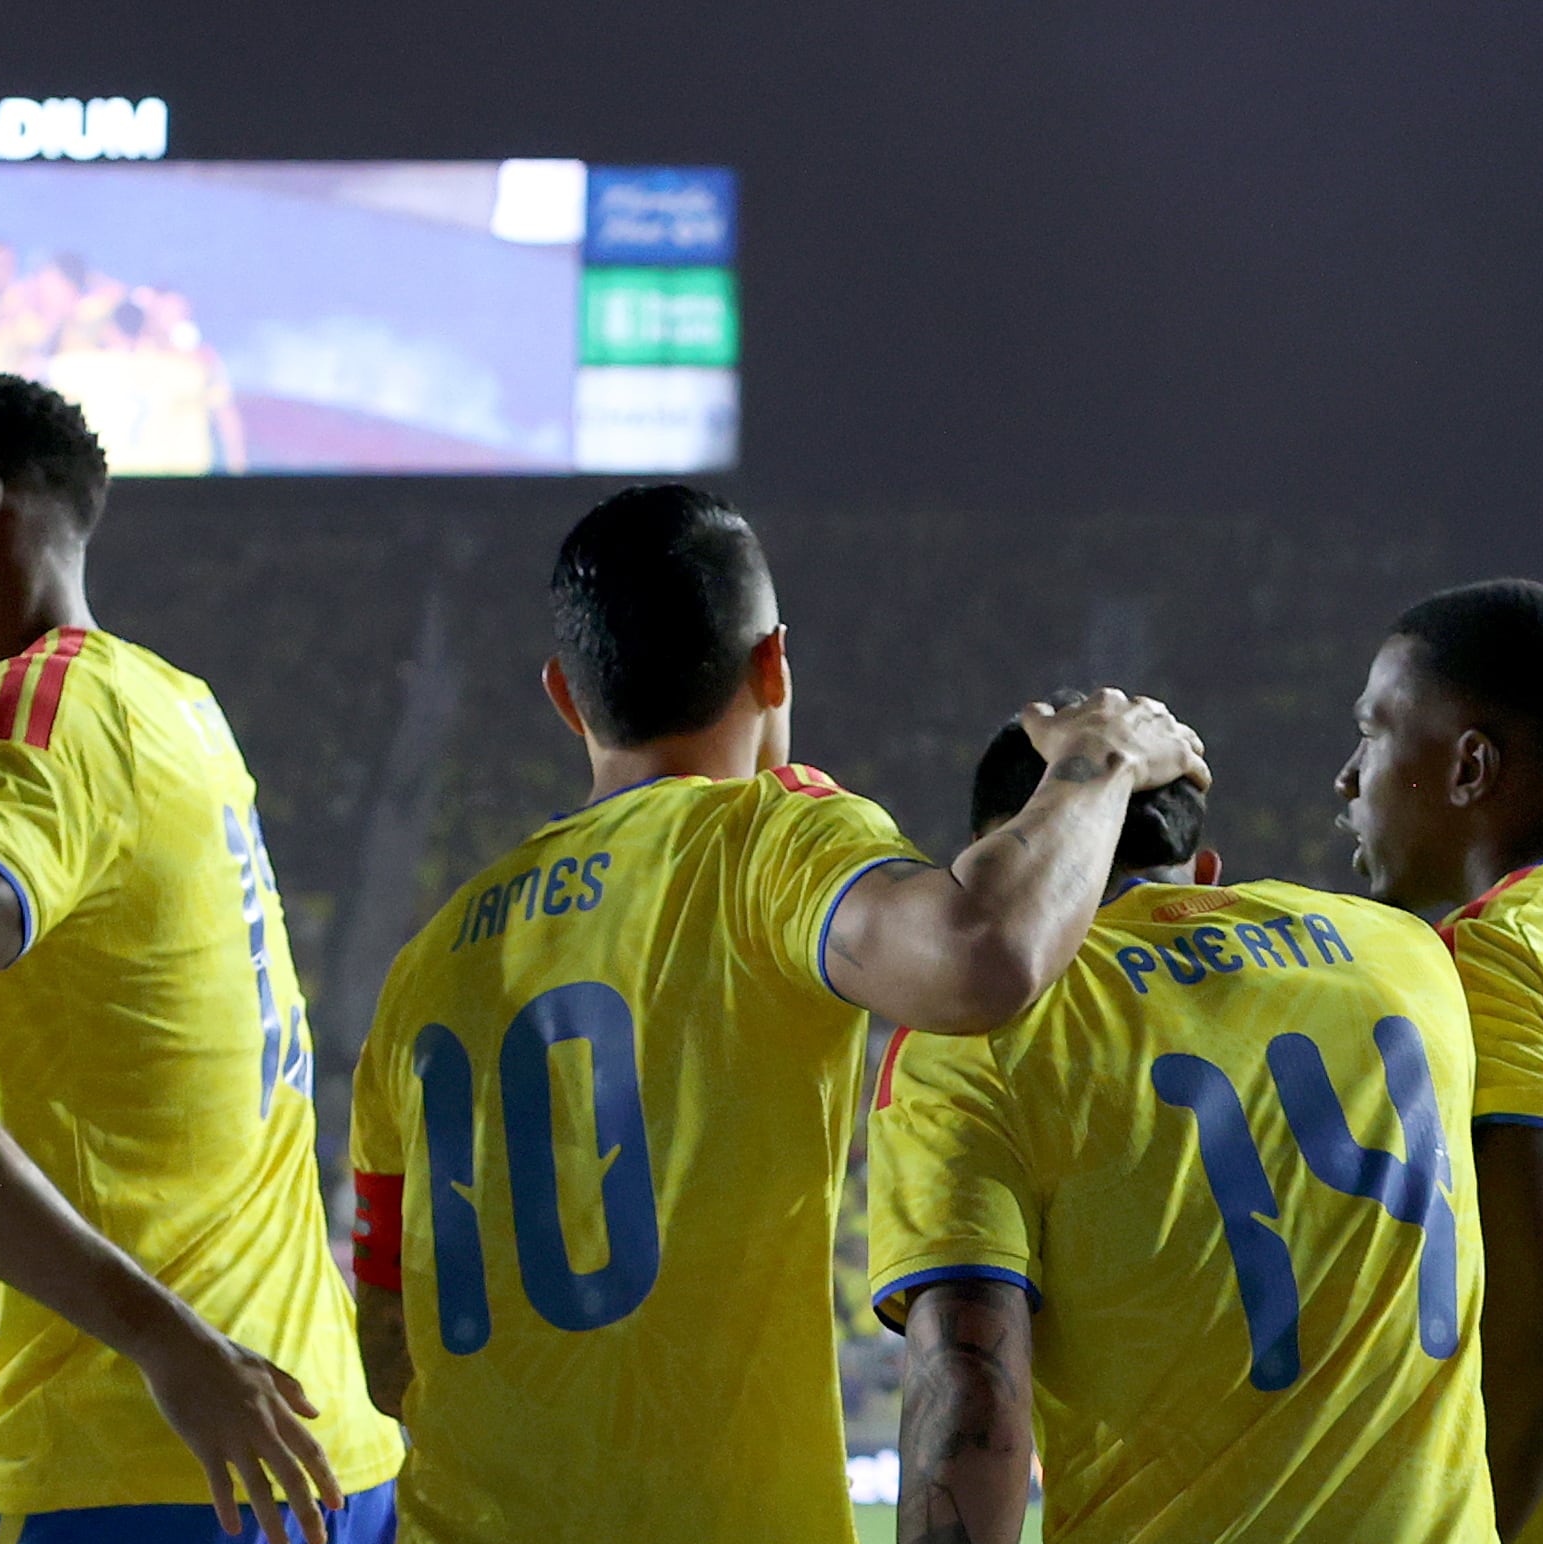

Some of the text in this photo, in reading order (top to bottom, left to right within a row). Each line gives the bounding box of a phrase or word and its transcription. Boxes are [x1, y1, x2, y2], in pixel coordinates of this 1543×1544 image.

[451, 851, 612, 953] JAMES
[1116, 913, 1354, 994] PUERTA
[412, 980, 661, 1356] 10
[1151, 1014, 1459, 1392] 14
